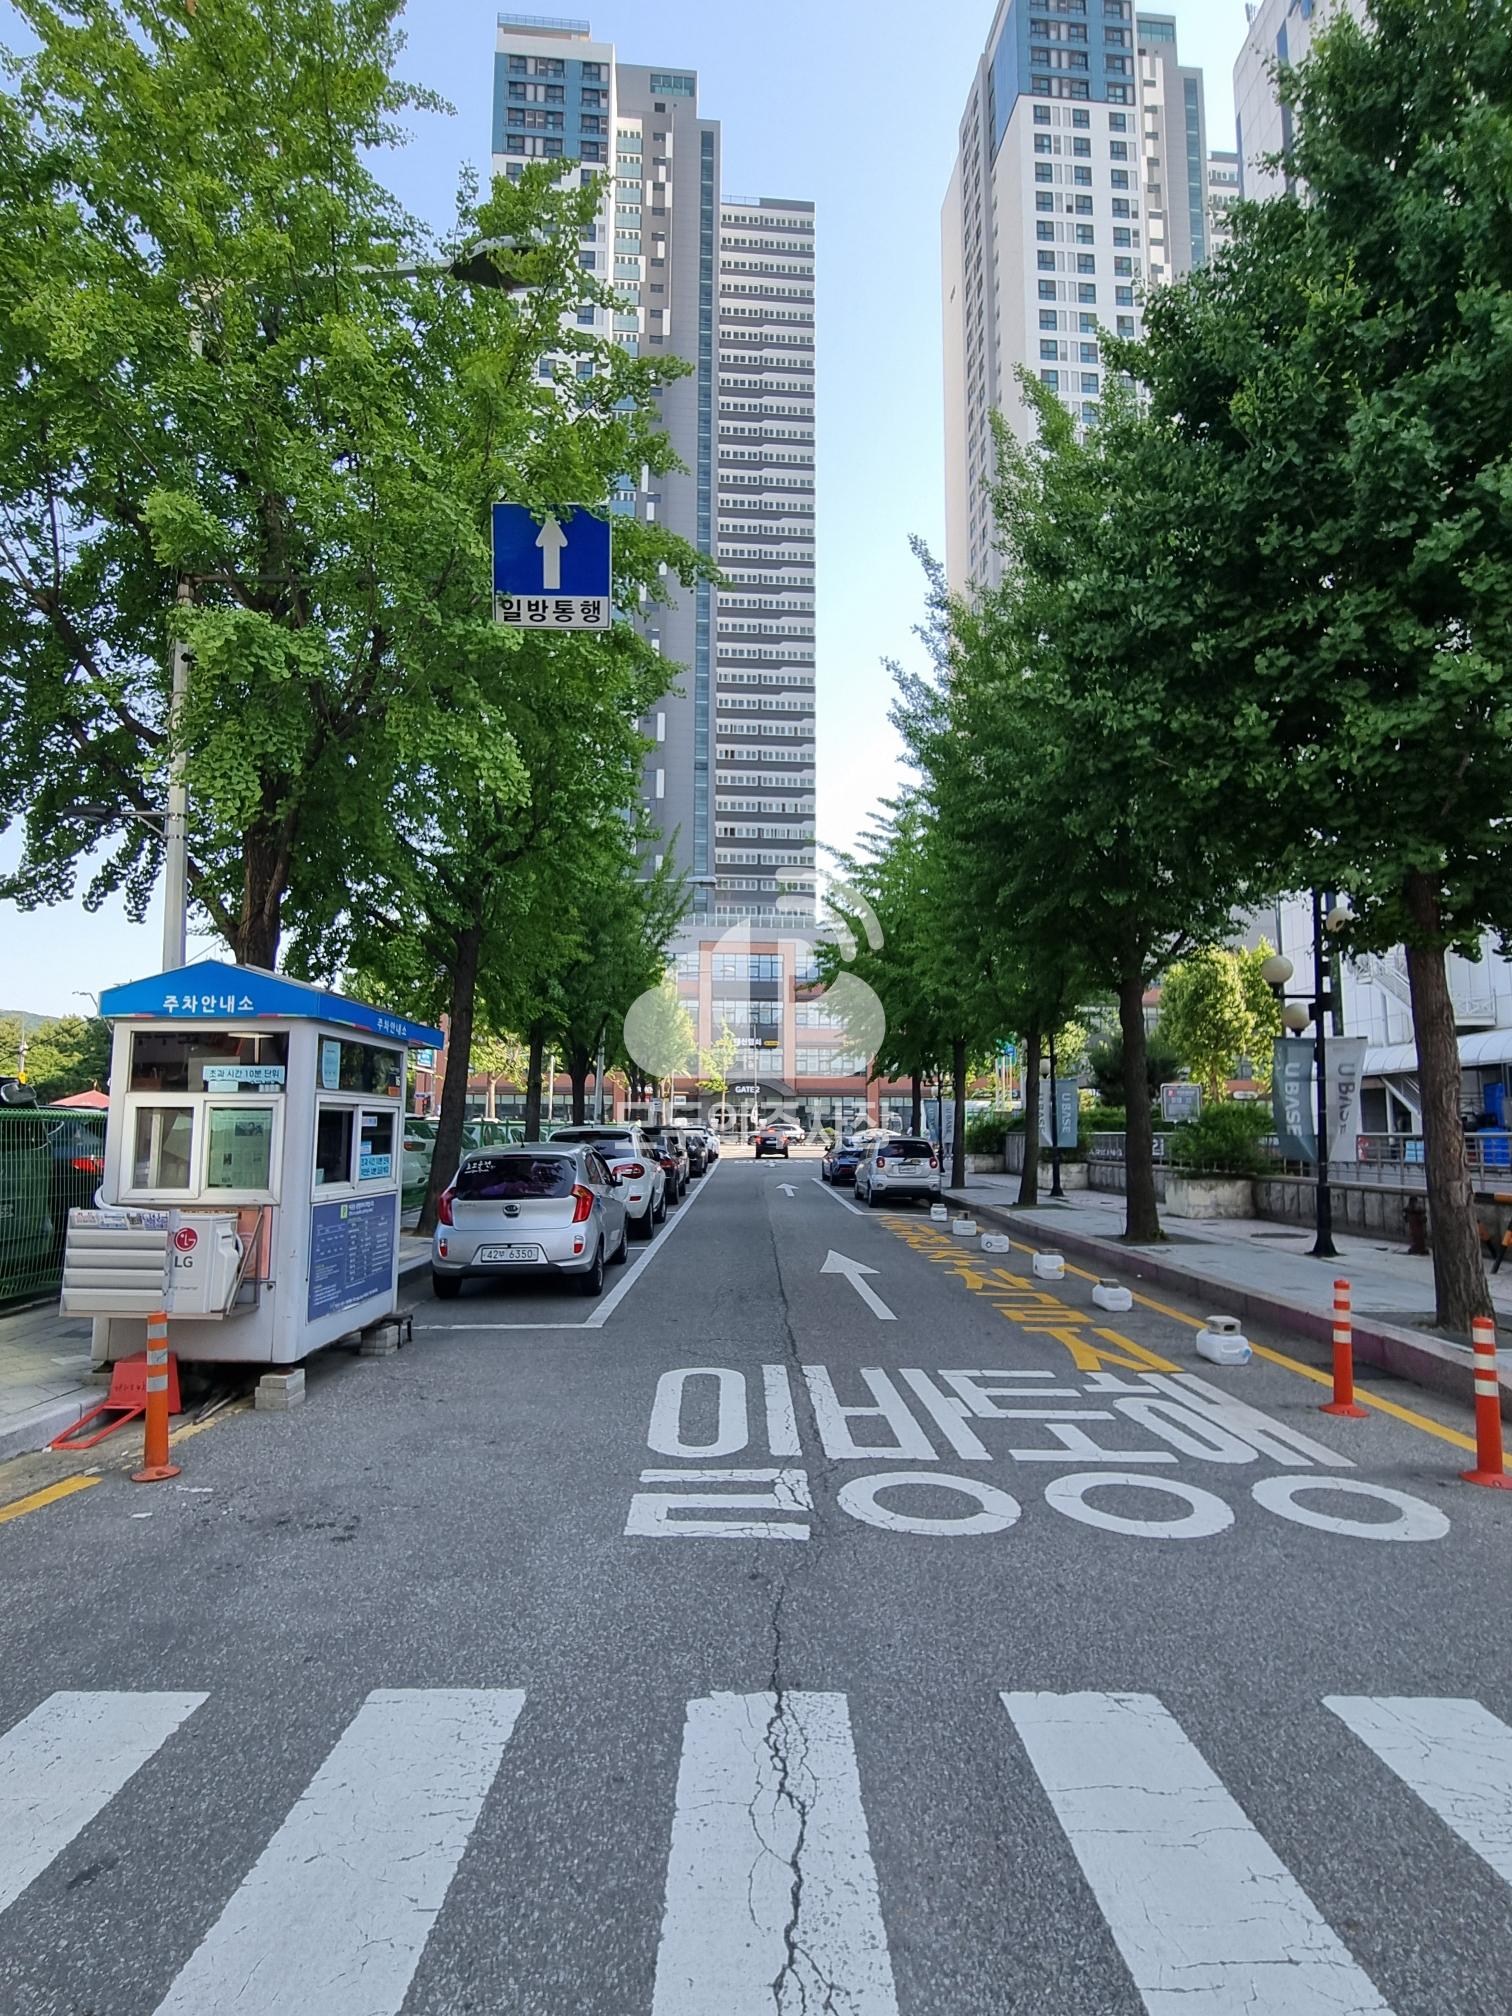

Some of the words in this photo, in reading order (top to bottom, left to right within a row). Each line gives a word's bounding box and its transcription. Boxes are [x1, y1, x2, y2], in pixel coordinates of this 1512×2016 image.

[501, 599, 601, 623] 일방통행
[163, 994, 255, 1012] 주차안내소
[377, 1018, 407, 1036] 주차안내소
[209, 1068, 225, 1078] 초과
[227, 1068, 242, 1078] 시간
[245, 1068, 262, 1078] 10분
[264, 1068, 280, 1079] 단위
[174, 1256, 193, 1268] LG
[509, 1249, 533, 1259] 6350
[624, 1364, 1451, 1542] 일방통행
